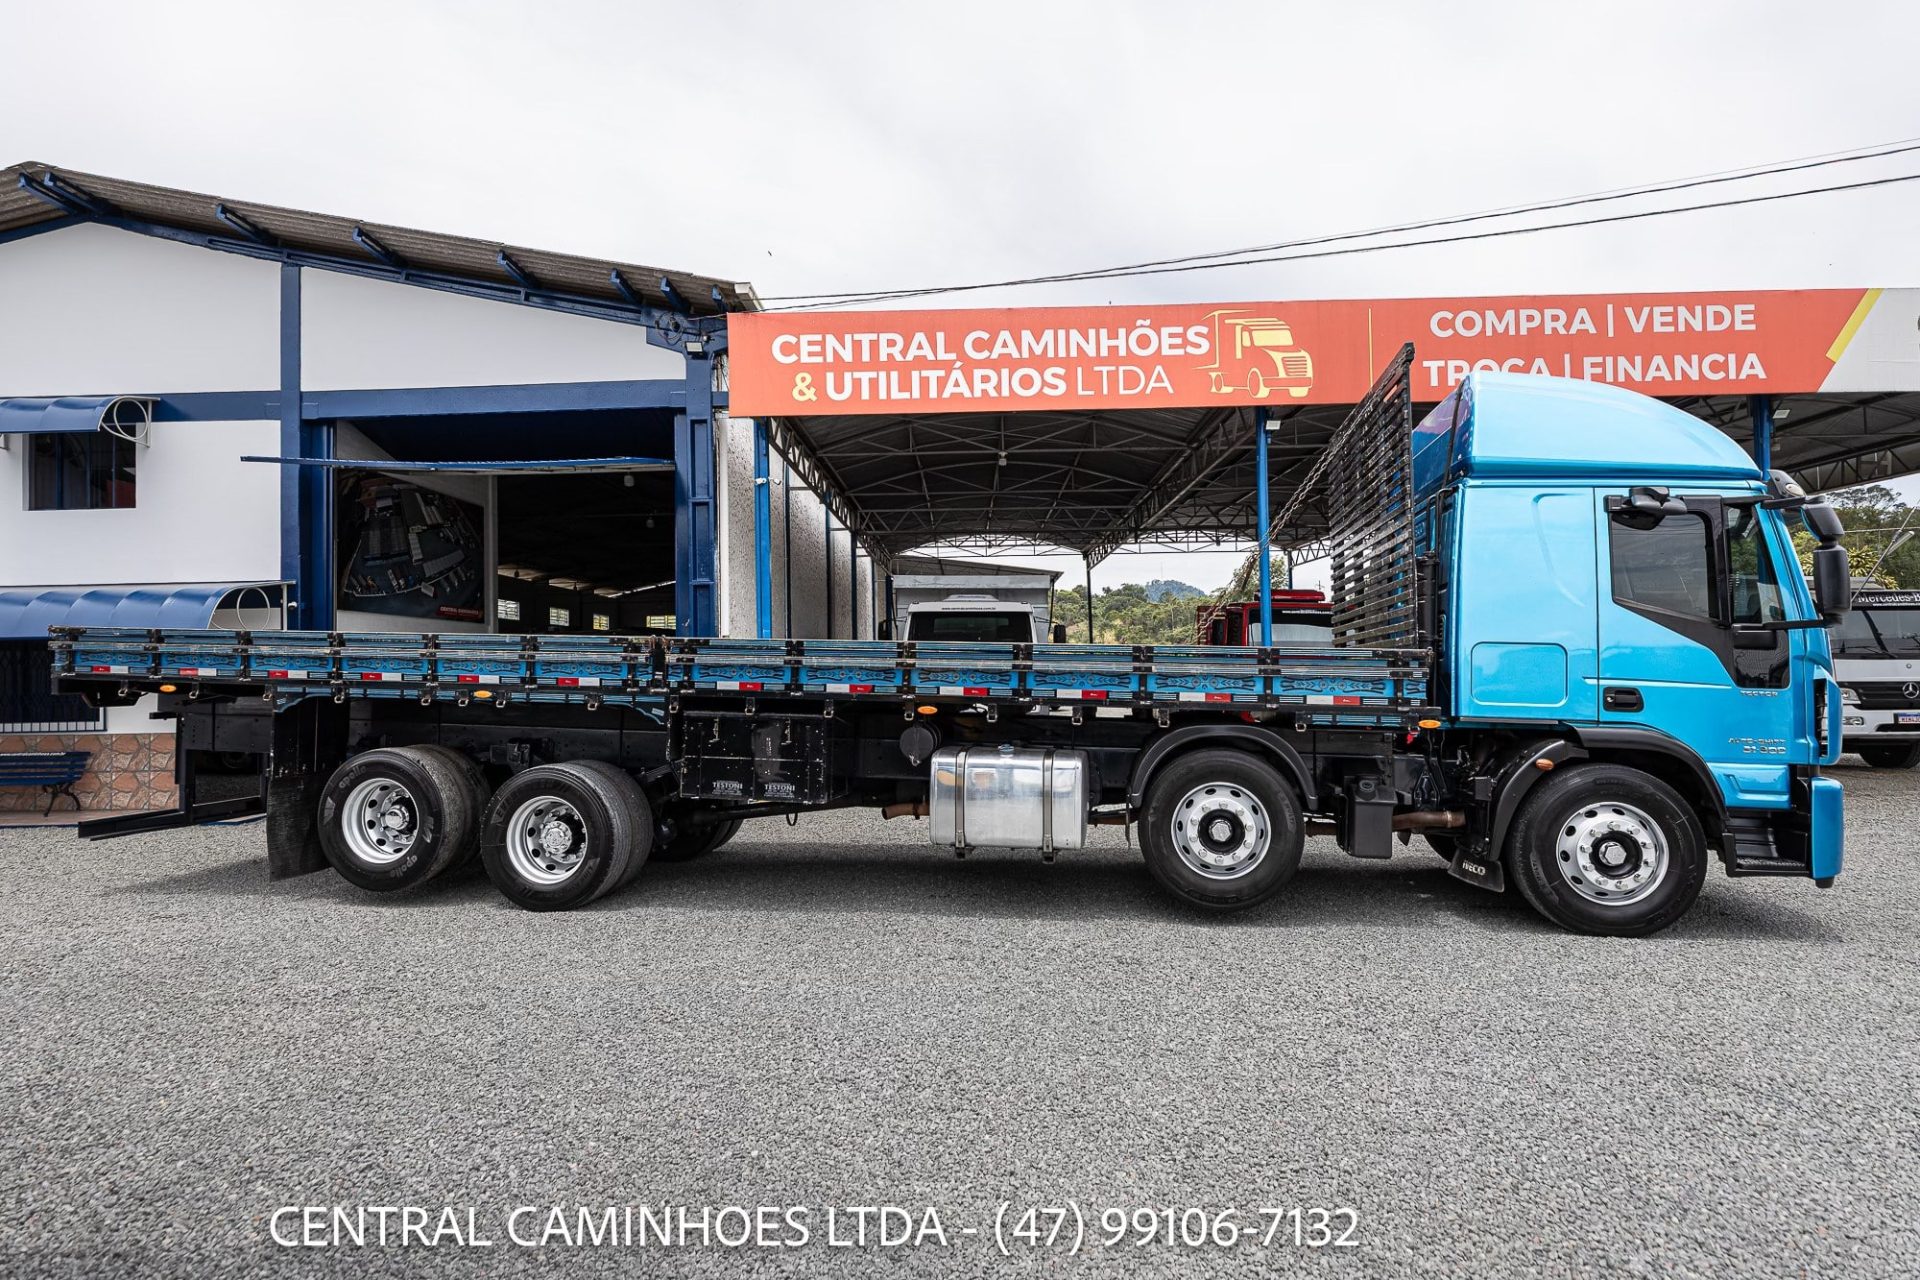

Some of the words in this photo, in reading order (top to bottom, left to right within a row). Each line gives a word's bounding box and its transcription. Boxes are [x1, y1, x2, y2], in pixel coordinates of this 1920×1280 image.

[1430, 307, 1596, 338] COMPRA
[1624, 304, 1756, 333] VENDE
[771, 332, 957, 364] CENTRAL
[963, 319, 1210, 361] CAMINHÕES
[791, 373, 817, 402] &
[825, 362, 1067, 401] UTILITÁRIOS
[1077, 365, 1174, 396] LTDA
[1583, 353, 1767, 383] FINANCIA
